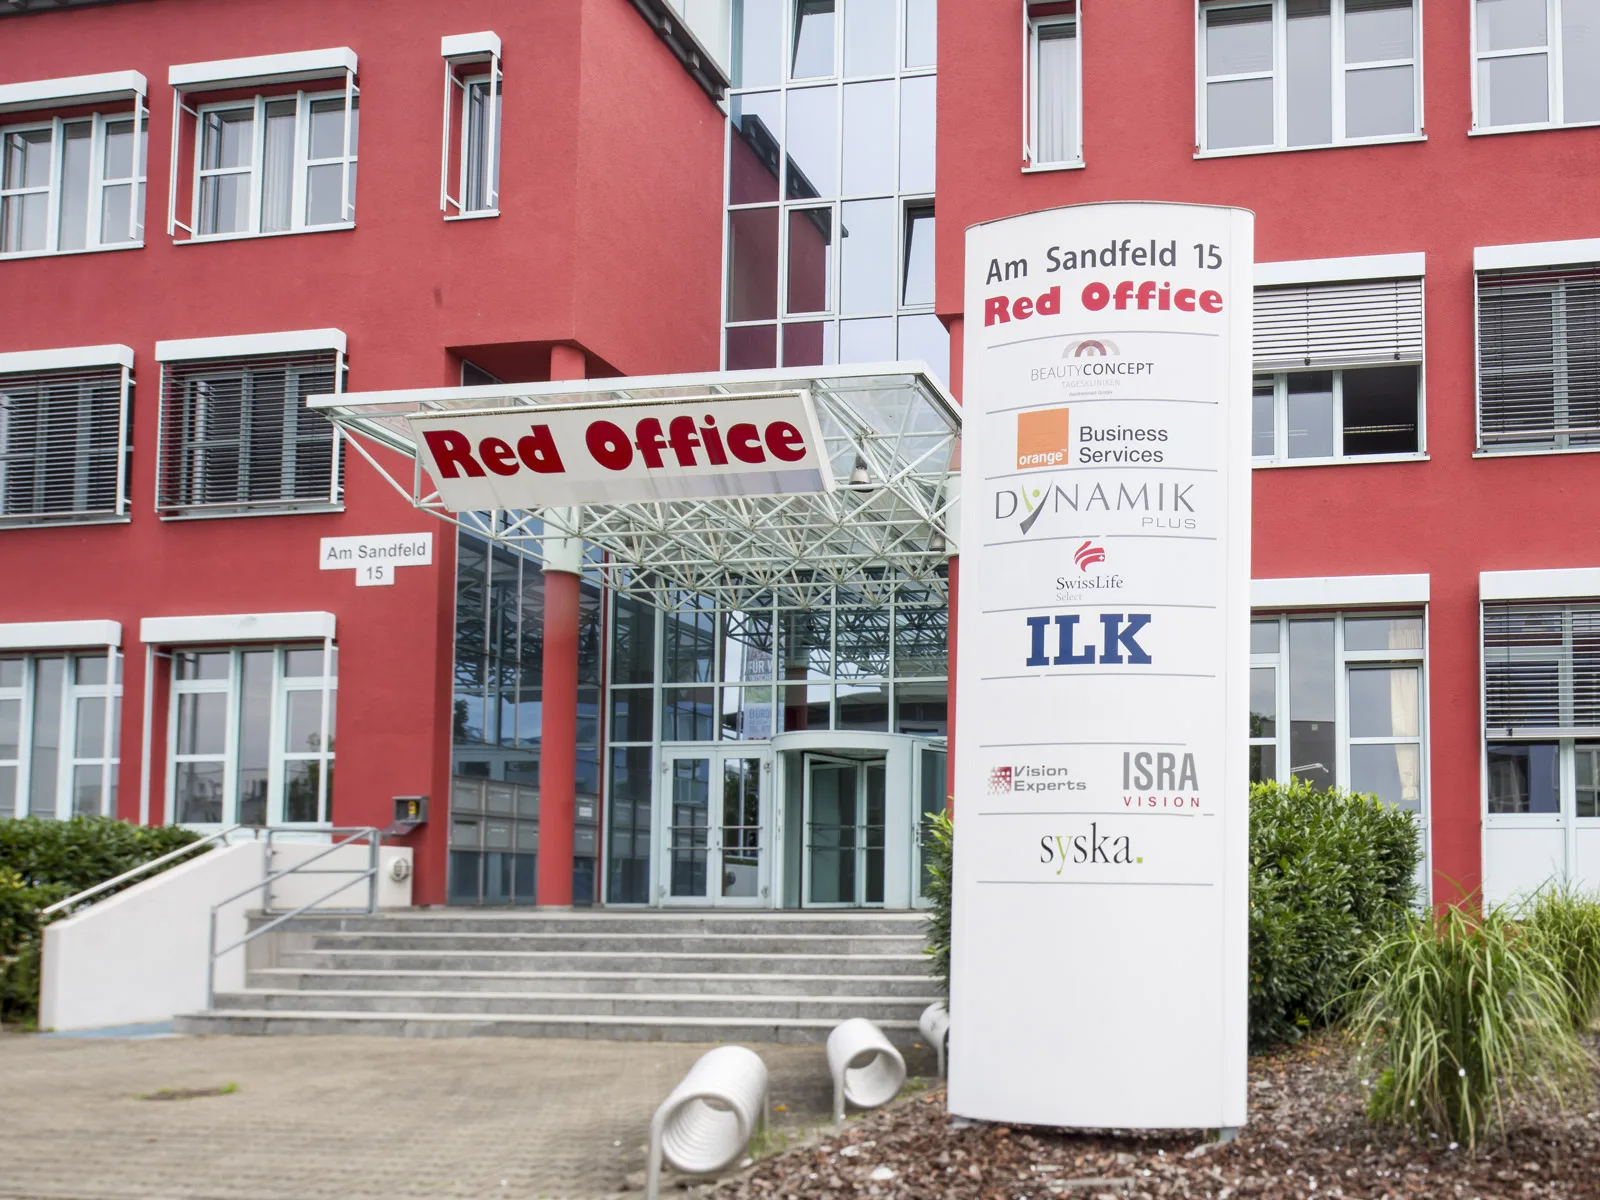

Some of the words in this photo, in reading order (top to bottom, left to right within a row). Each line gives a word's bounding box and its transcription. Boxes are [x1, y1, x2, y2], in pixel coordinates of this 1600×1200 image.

[986, 258, 1028, 285] Am
[1046, 239, 1177, 273] Sandfeld
[1193, 243, 1223, 270] 15
[984, 285, 1061, 327] Red
[1081, 280, 1224, 314] Office
[1079, 425, 1169, 443] Business
[422, 424, 566, 479] Red
[585, 413, 808, 472] Office
[1079, 446, 1164, 464] Services
[1018, 451, 1064, 466] orange
[995, 478, 1196, 536] DYNAMIK
[1141, 516, 1197, 530] PLUS
[326, 546, 353, 560] Am
[357, 542, 425, 559] Sandfeld
[365, 566, 384, 581] 15
[1055, 593, 1083, 602] Select
[1026, 613, 1153, 667] ILK
[1014, 764, 1068, 777] Vision
[1123, 752, 1199, 791] ISRA
[1014, 779, 1087, 793] Experts
[1123, 796, 1200, 807] VISION
